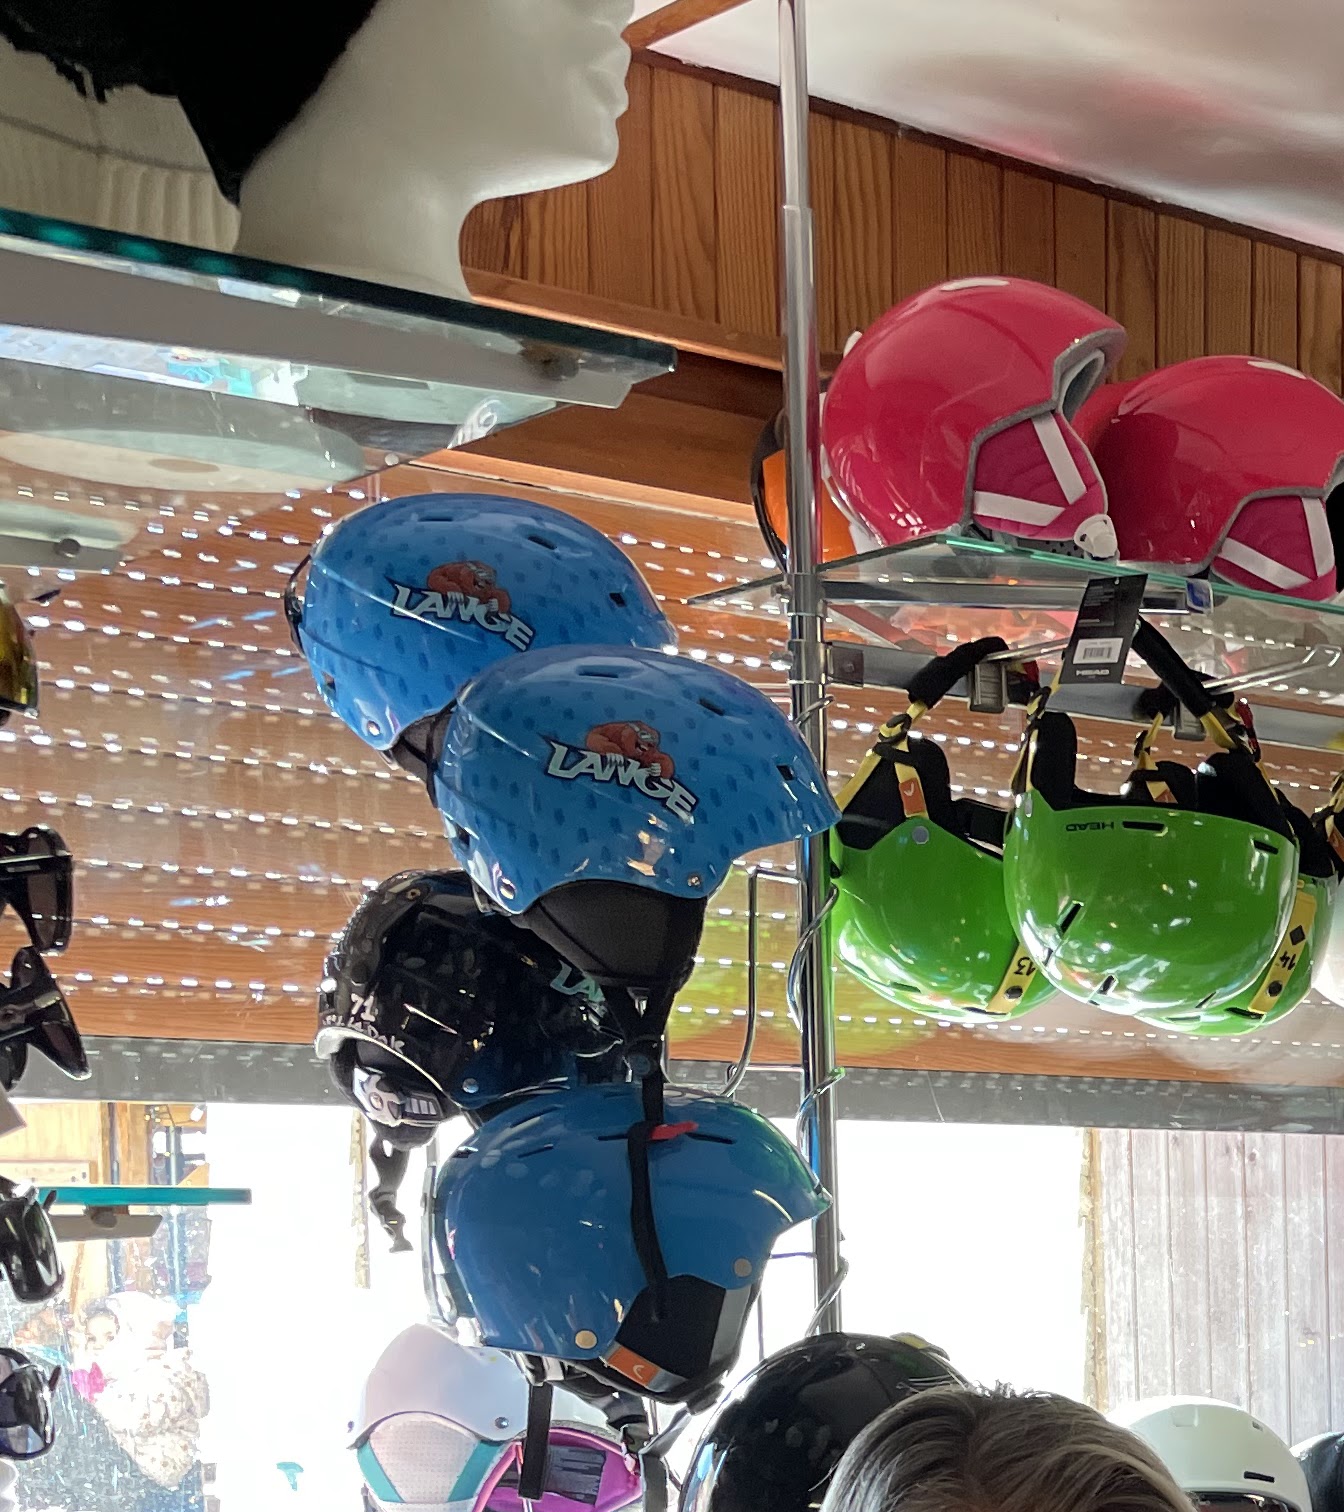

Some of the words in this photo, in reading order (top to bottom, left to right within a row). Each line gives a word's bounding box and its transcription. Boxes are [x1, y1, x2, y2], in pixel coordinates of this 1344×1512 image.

[389, 581, 536, 652] LANGE
[1076, 668, 1110, 677] HEAD
[541, 731, 702, 821] LANGE
[1065, 821, 1115, 832] HEAD
[1013, 956, 1036, 976] 13
[1279, 951, 1297, 971] 14
